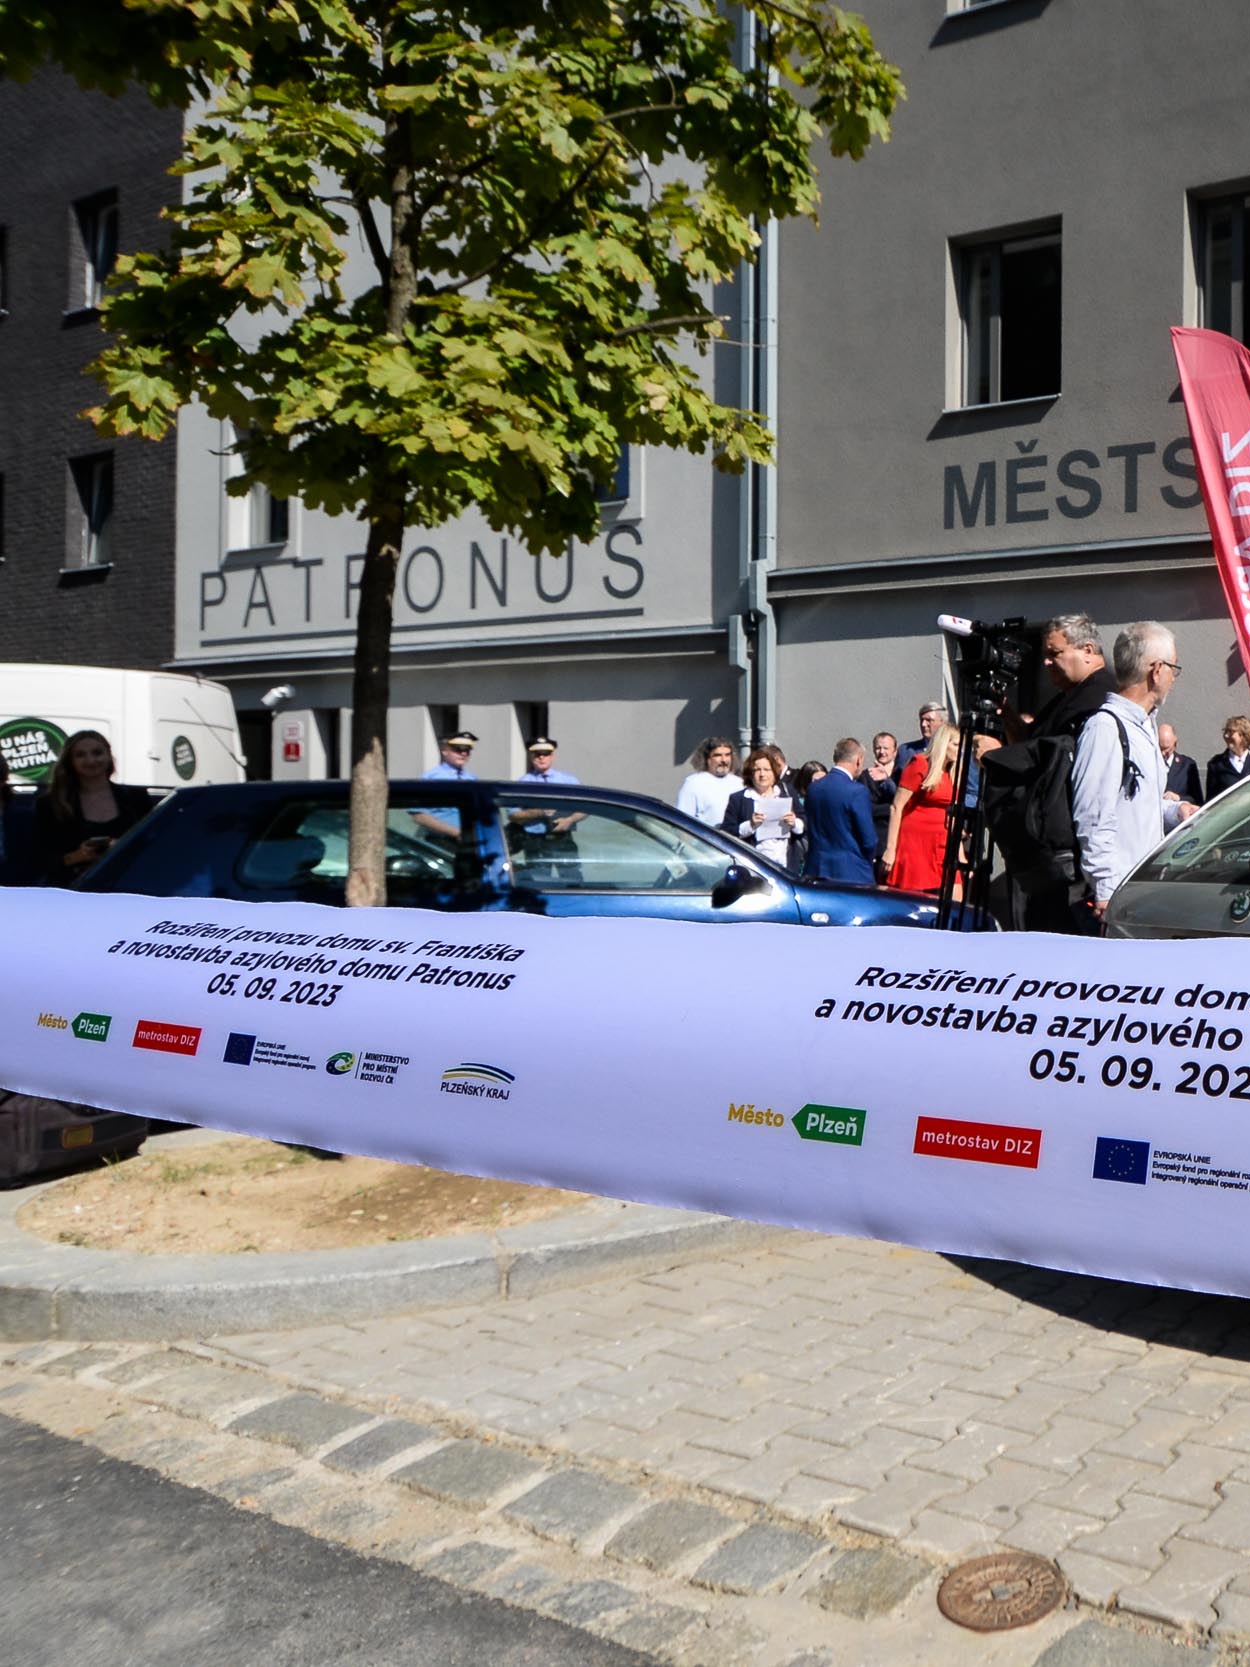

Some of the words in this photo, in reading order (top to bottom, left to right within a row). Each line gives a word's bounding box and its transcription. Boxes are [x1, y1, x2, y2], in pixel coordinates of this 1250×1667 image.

[5, 749, 59, 771] HUTNÁ
[145, 920, 239, 940] Rozšíření
[228, 927, 319, 947] provozu
[316, 932, 383, 953] domu
[383, 940, 413, 956] sv.
[412, 940, 525, 962] Františka
[107, 940, 126, 954] a
[121, 940, 233, 965] novostavba
[230, 950, 338, 976] azylového
[337, 957, 408, 982] domu
[404, 962, 517, 991] Patronus
[206, 972, 241, 997] 05.
[243, 976, 279, 1001] 09.
[279, 979, 344, 1008] 2023
[855, 966, 1017, 996] Rozšíření
[1012, 978, 1165, 1006] provozu
[36, 1012, 68, 1031] Město
[77, 1018, 106, 1037] Plzeň
[814, 998, 837, 1018] a
[841, 1000, 1038, 1035] novostavba
[1046, 1013, 1243, 1052] azylového
[137, 1028, 180, 1046] metrostav
[180, 1034, 197, 1048] DIZ
[1029, 1048, 1086, 1084] 05.
[1101, 1054, 1161, 1091] 09.
[440, 1081, 485, 1098] PLZEŇSKÝ
[485, 1087, 511, 1101] KRAJ
[728, 1102, 785, 1129] Město
[805, 1112, 859, 1139] Plzeň
[922, 1130, 1000, 1154] metrostav
[1003, 1137, 1034, 1156] DIZ
[1152, 1161, 1181, 1172] Evropský
[1181, 1163, 1196, 1174] fond
[1197, 1166, 1208, 1176] pro
[1209, 1168, 1241, 1180] regionální
[1153, 1150, 1192, 1163] EVROPSKÁ
[1193, 1156, 1211, 1165] UNIE
[1151, 1171, 1187, 1185] Integrovaný
[1187, 1176, 1219, 1187] regionální
[1219, 1180, 1248, 1191] operační
